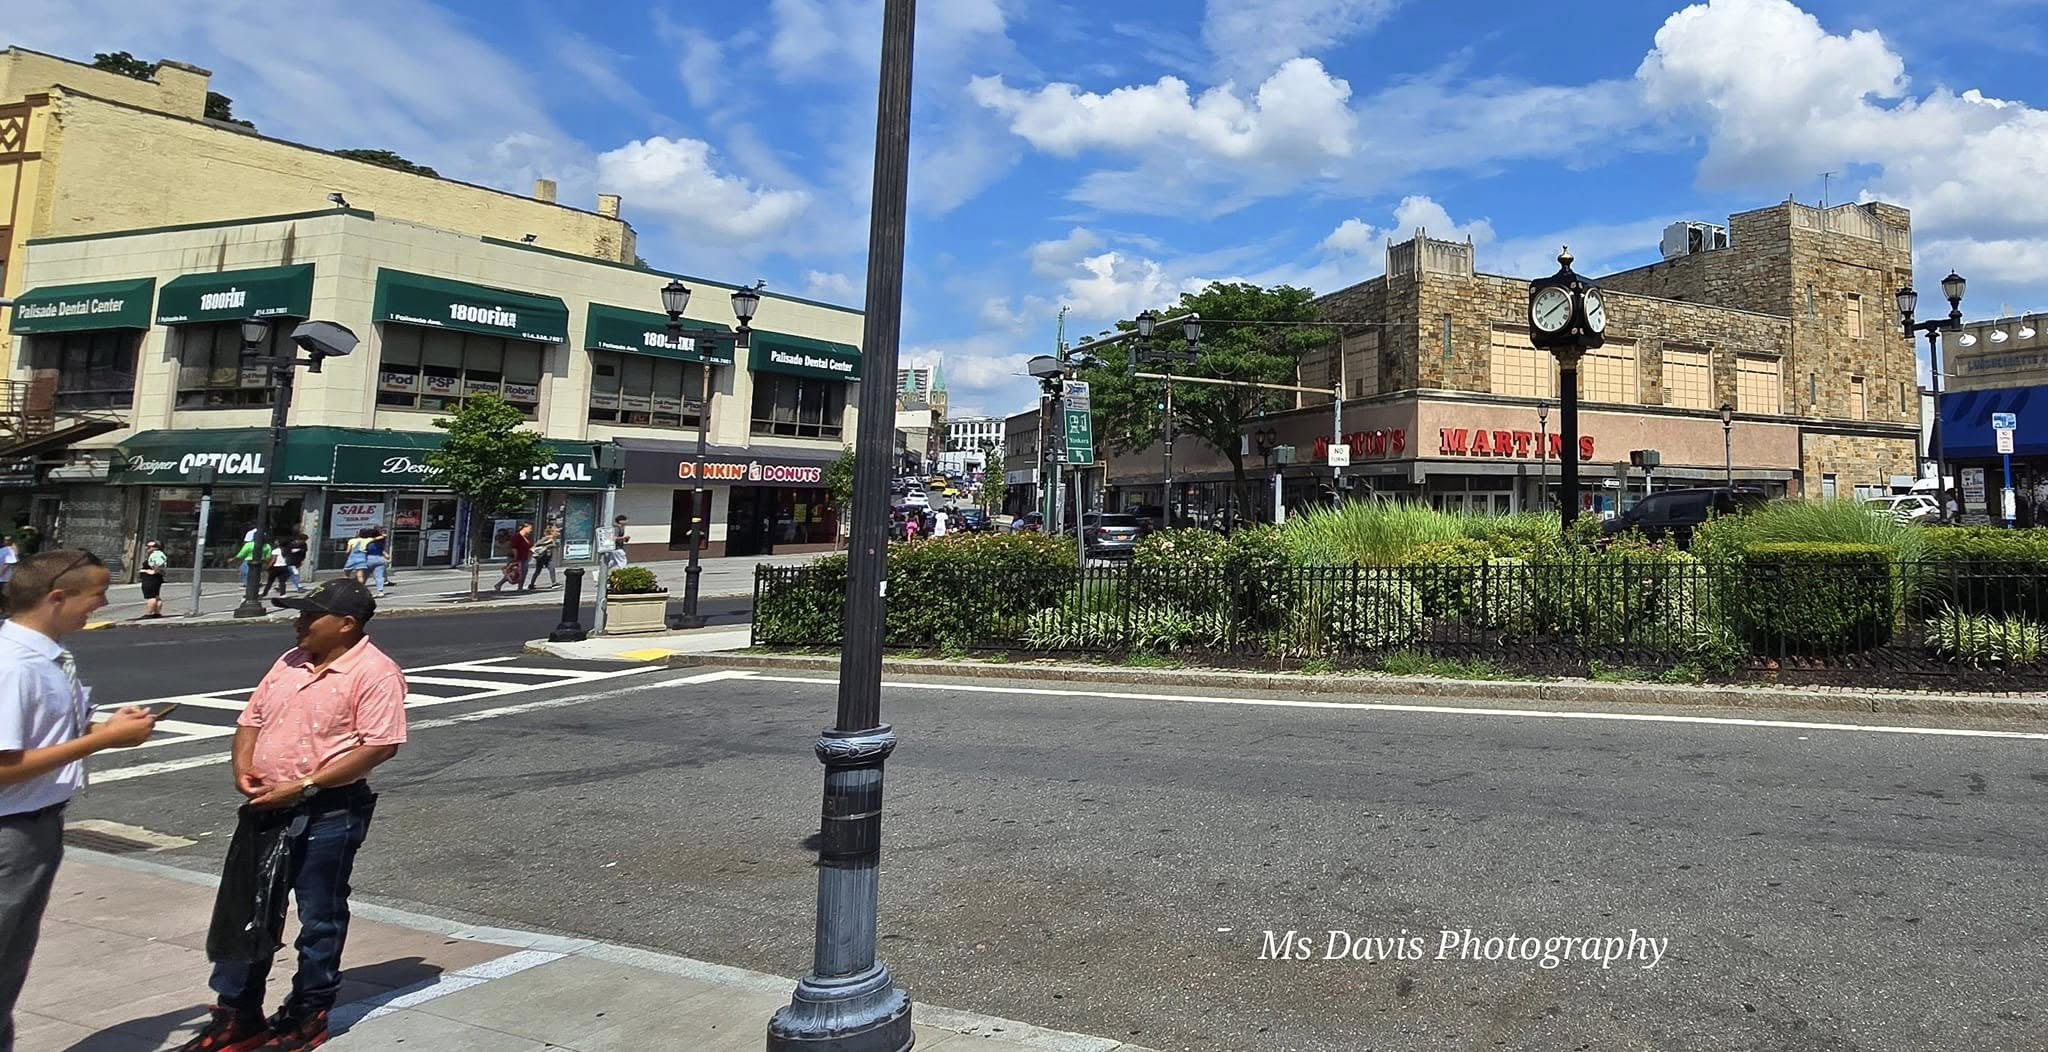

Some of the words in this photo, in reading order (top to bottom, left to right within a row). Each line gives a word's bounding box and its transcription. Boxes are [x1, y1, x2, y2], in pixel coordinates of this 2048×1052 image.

[18, 303, 58, 319] Palisade
[58, 300, 90, 316] Dental
[91, 298, 124, 314] Center
[770, 350, 803, 366] Palisade
[804, 355, 828, 369] Dental
[829, 359, 853, 372] Center
[382, 372, 413, 385] iPod
[427, 376, 455, 388] PSP
[464, 381, 498, 392] Laptop
[504, 385, 535, 396] Robot
[128, 455, 177, 475] Designer
[763, 465, 821, 482] DONUTS
[337, 505, 376, 515] SALE
